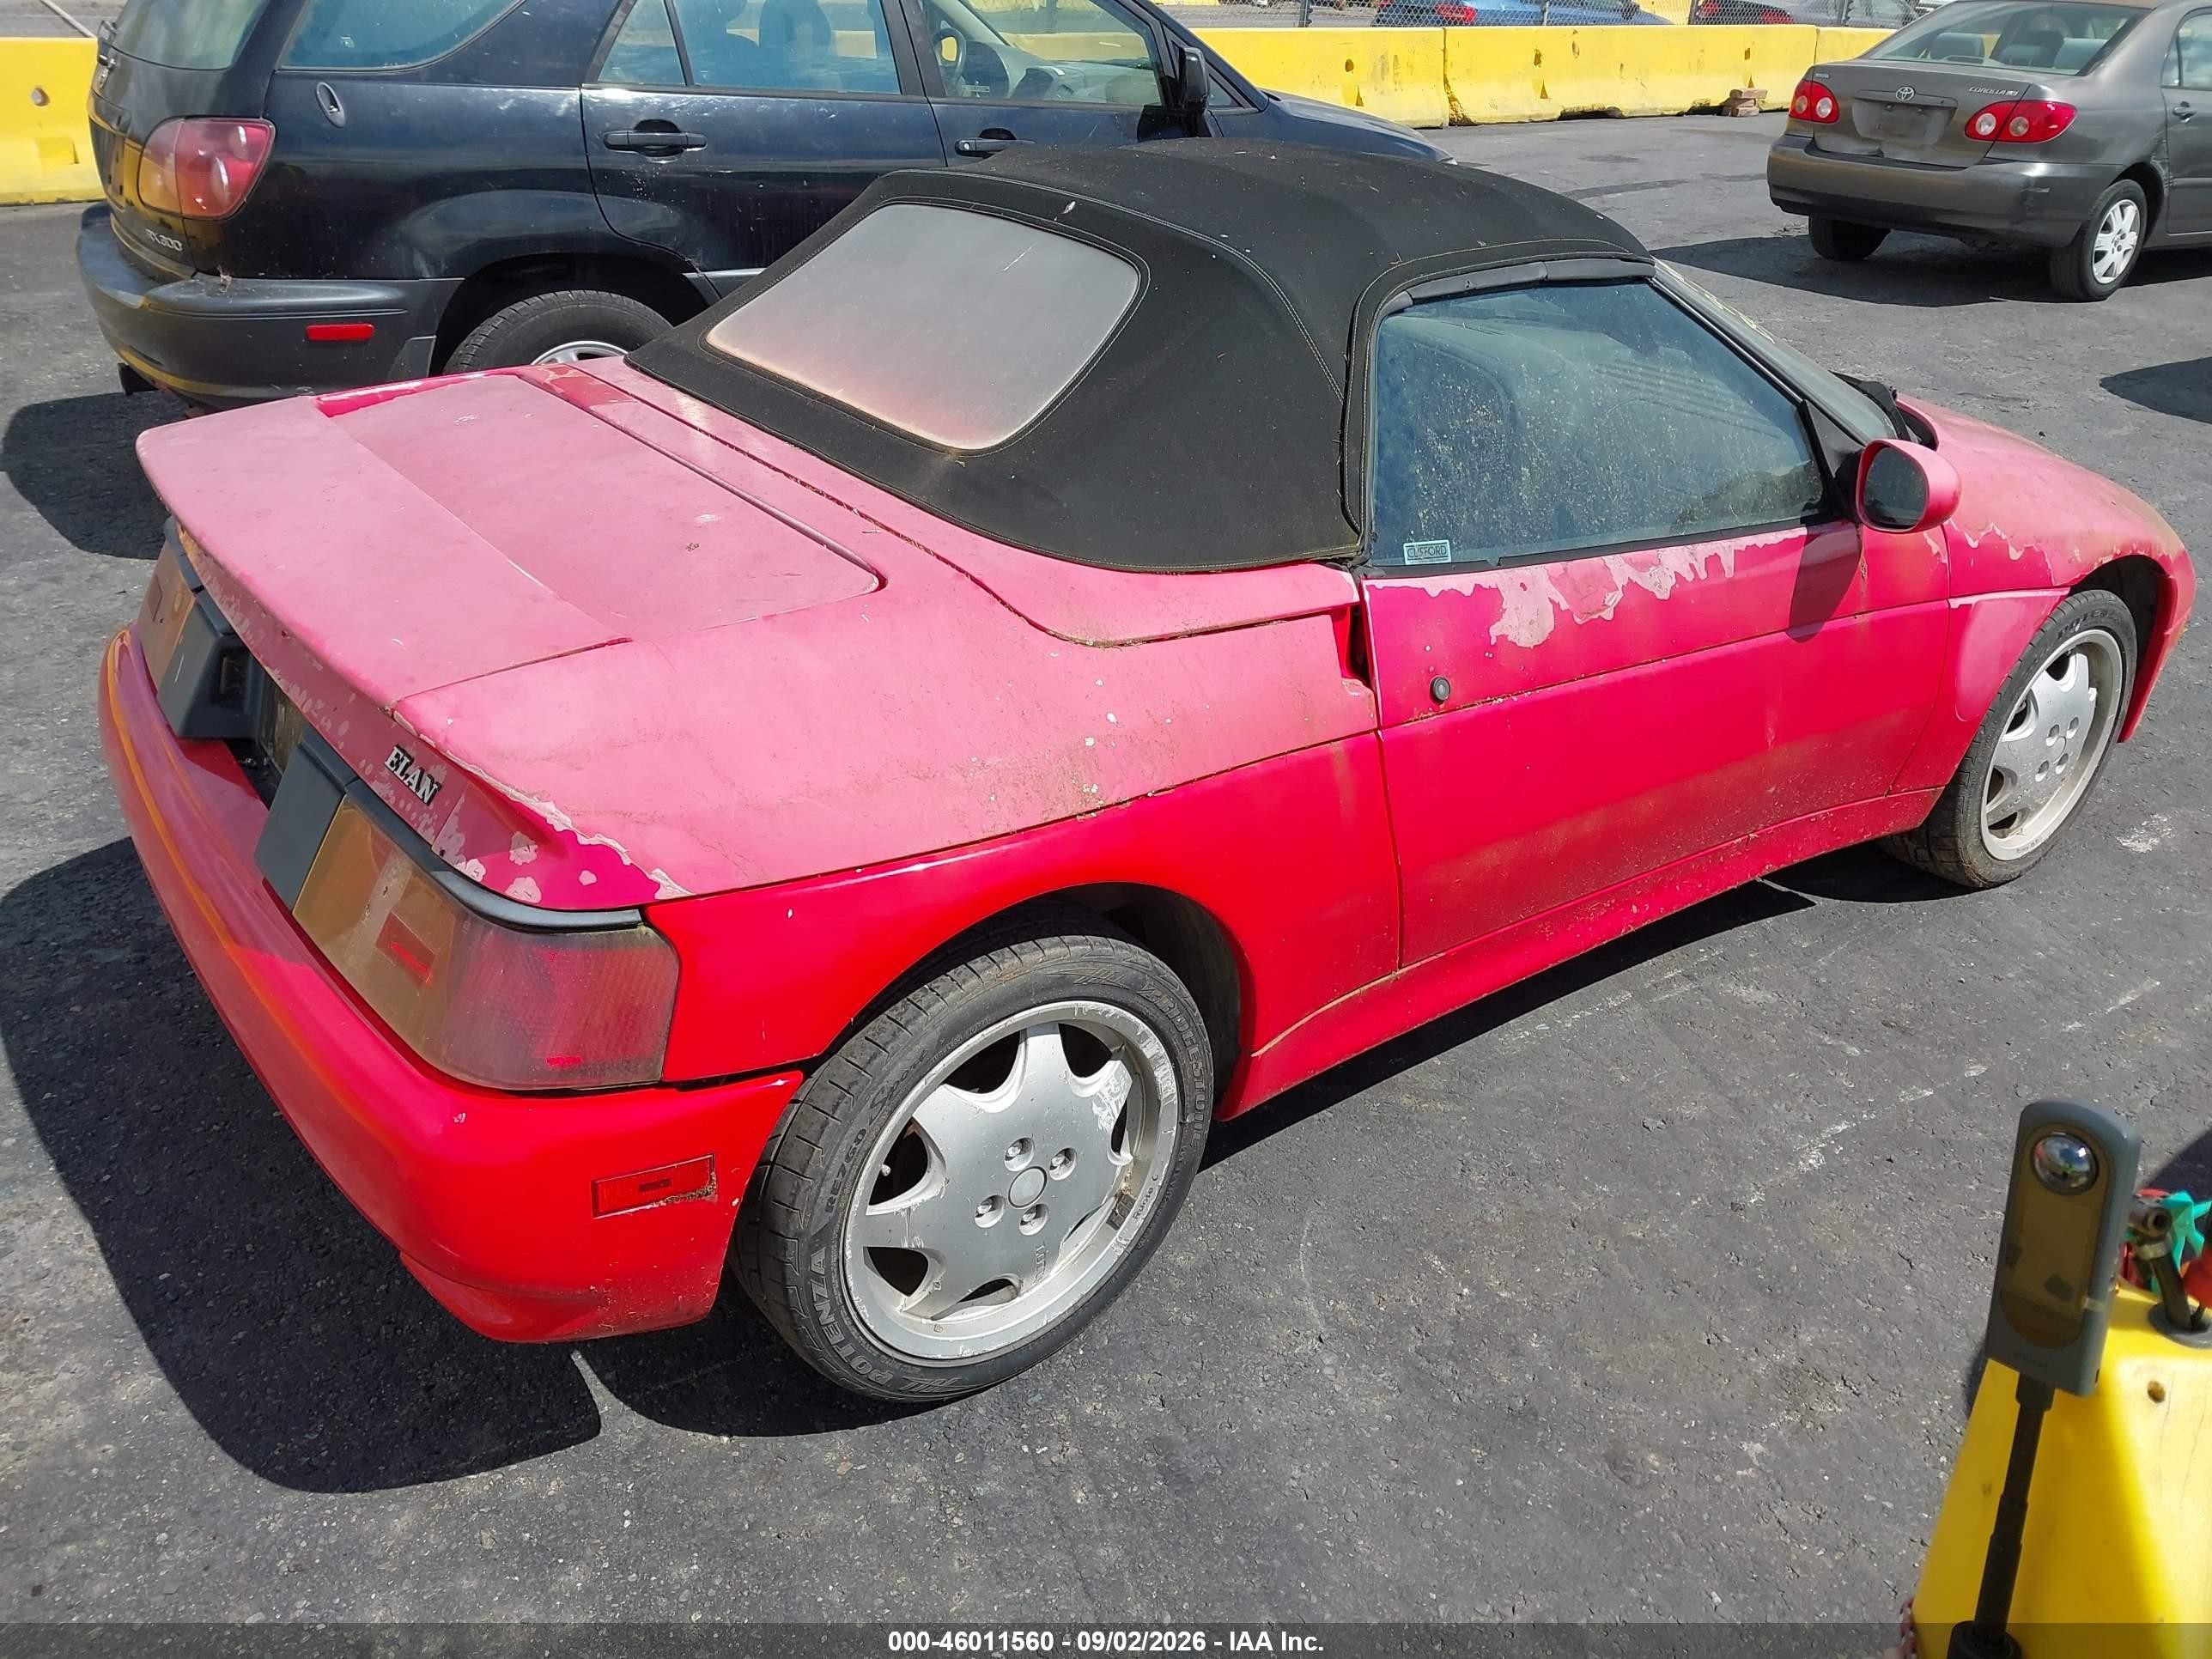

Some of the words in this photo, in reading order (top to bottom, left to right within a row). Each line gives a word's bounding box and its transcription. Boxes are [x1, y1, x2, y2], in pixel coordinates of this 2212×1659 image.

[1968, 86, 2007, 96] COROLLA
[384, 744, 442, 805] ELAN
[810, 1246, 894, 1386] POTENZA
